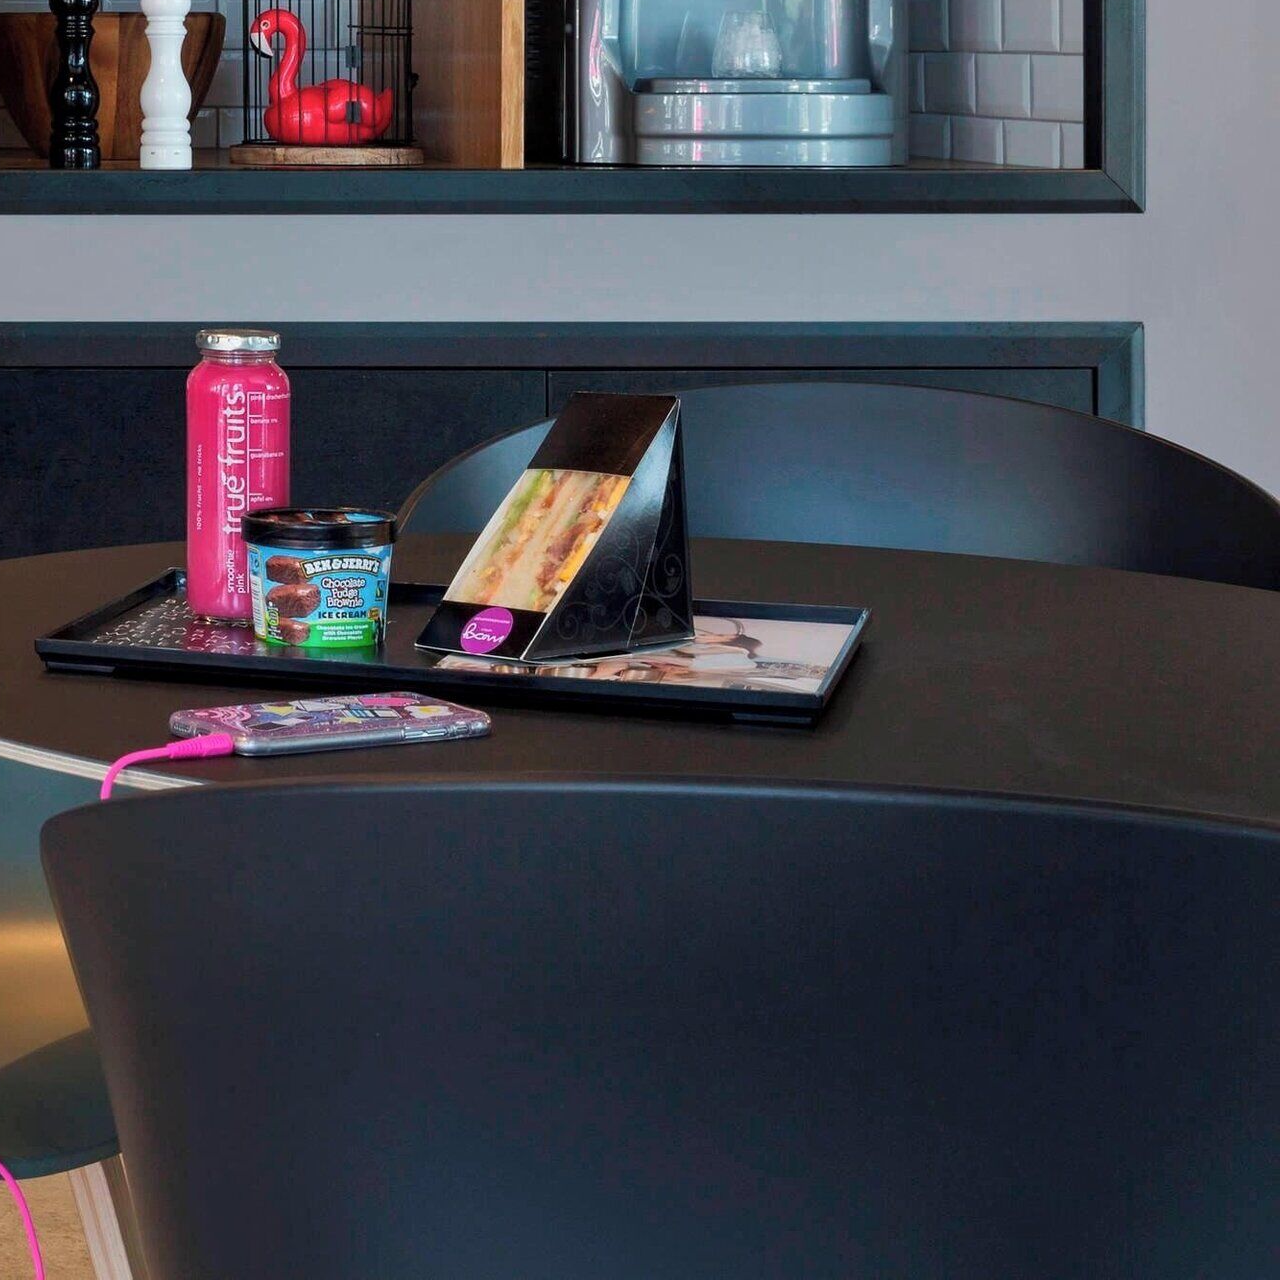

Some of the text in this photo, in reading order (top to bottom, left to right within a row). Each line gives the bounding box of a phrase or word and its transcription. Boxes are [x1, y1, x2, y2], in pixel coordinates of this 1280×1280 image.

[217, 391, 246, 535] true fruits
[225, 550, 236, 594] smoothie
[236, 573, 246, 594] pink
[322, 578, 366, 589] Chocolate
[332, 588, 358, 598] Fudge
[327, 598, 364, 608] Brownie
[336, 610, 367, 618] CREAM
